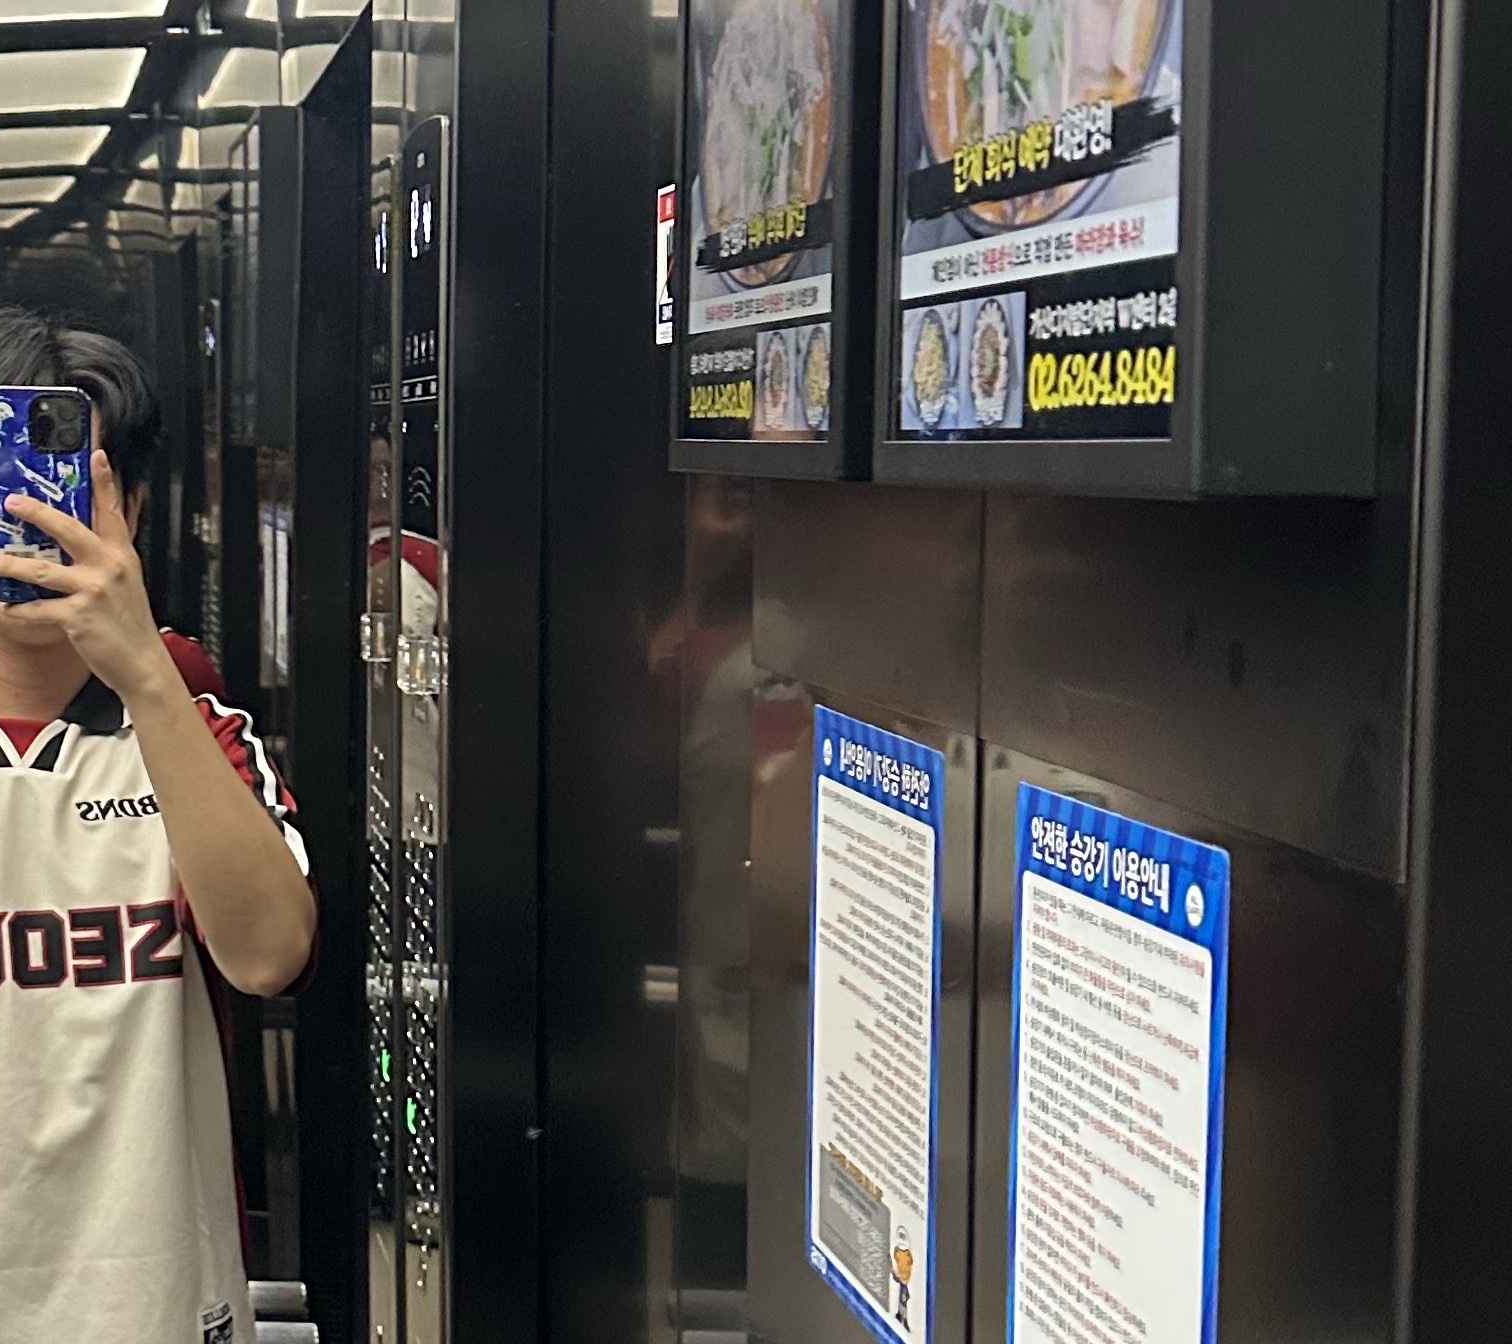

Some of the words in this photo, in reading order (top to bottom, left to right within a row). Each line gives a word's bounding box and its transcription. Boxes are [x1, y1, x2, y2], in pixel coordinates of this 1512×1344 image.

[953, 142, 984, 193] 단체
[985, 131, 1017, 182] 회식
[1018, 119, 1052, 172] 예약
[1030, 814, 1068, 871] 안전한
[1069, 829, 1109, 888] 승강기
[1112, 846, 1170, 914] 이용안내
